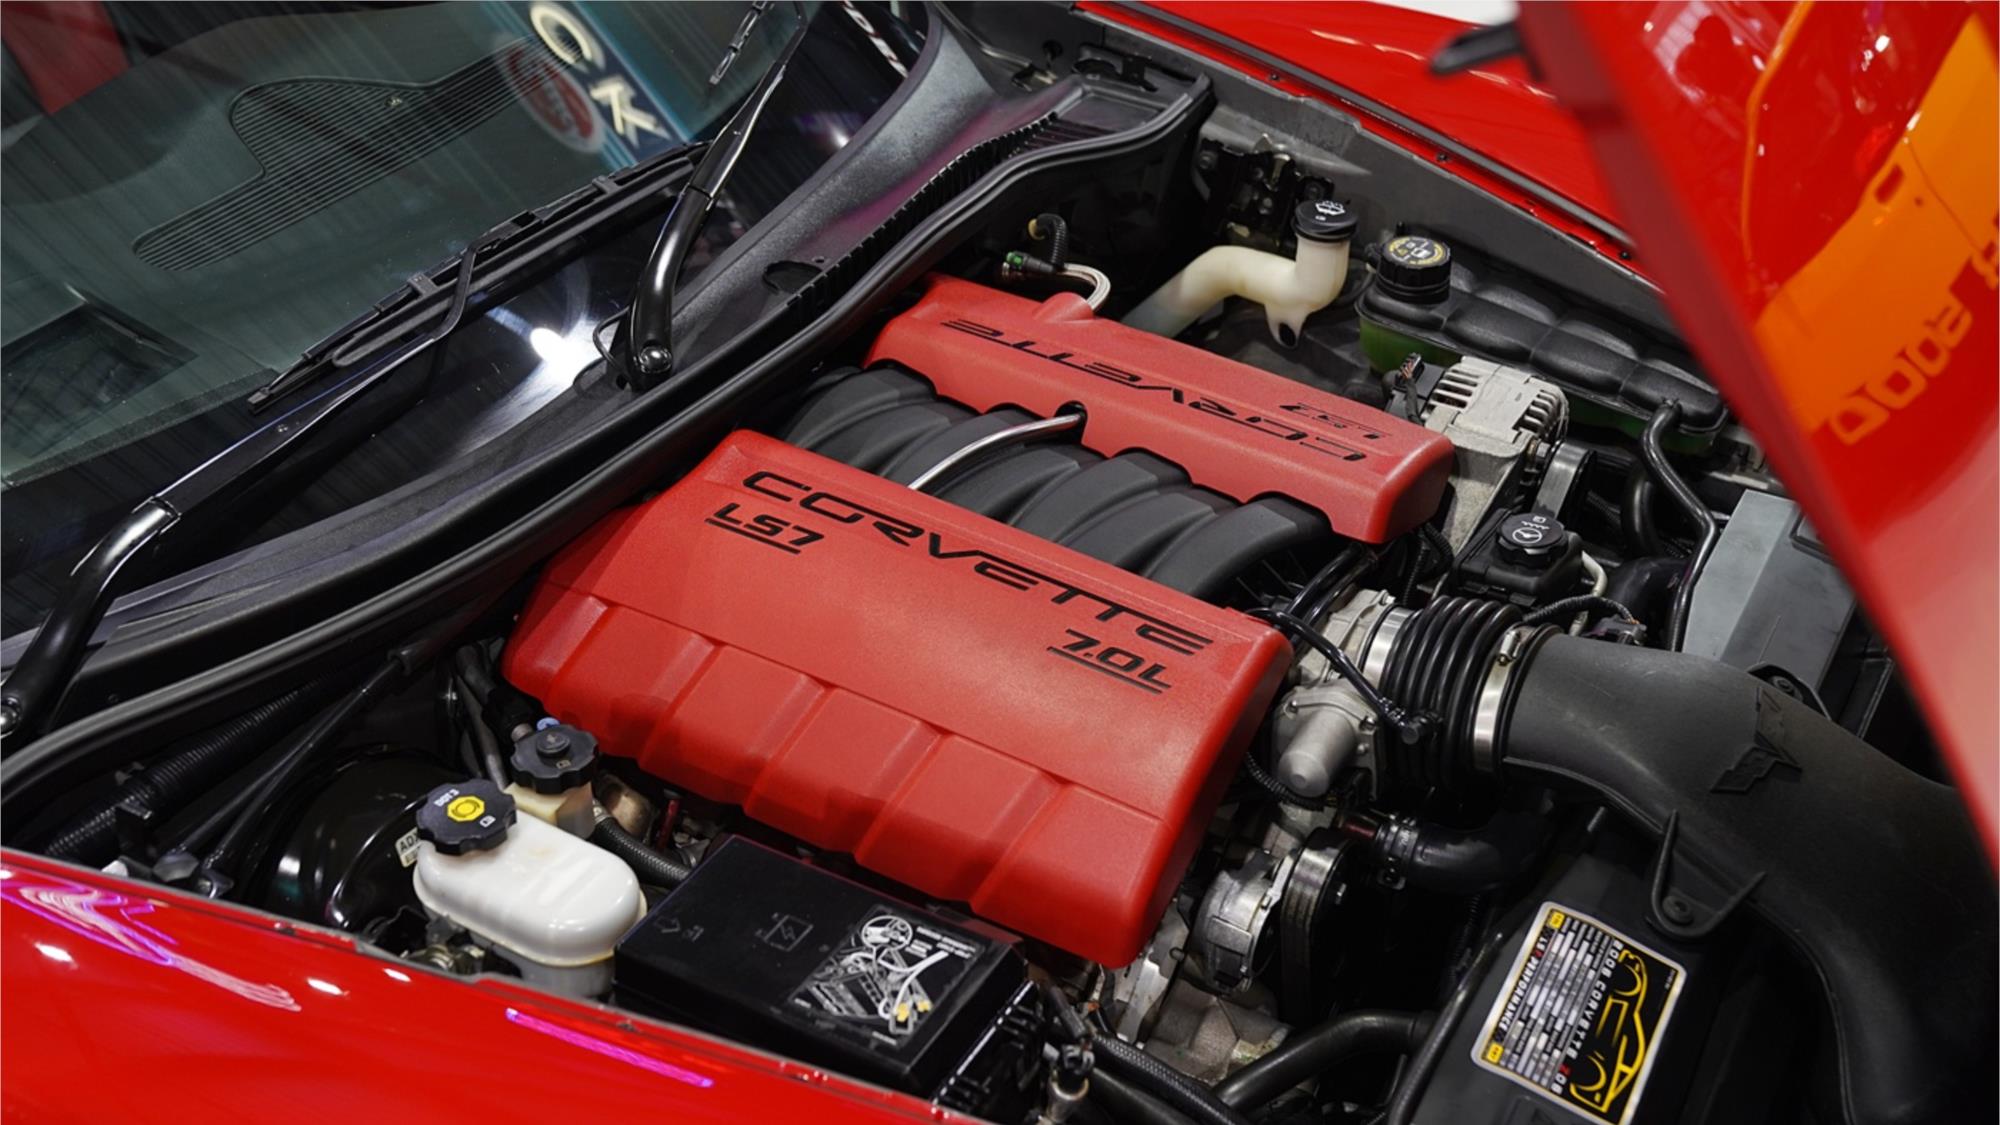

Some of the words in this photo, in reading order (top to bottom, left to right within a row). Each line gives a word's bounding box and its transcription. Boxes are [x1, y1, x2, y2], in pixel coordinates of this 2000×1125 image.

[941, 318, 1367, 461] CORVETTE
[710, 502, 825, 549] LS7
[742, 470, 1214, 656] CORVETTE
[1060, 628, 1172, 690] 7.0L
[1498, 957, 1540, 1032] PERFORMANCE
[1566, 982, 1607, 1060] CORVETTE
